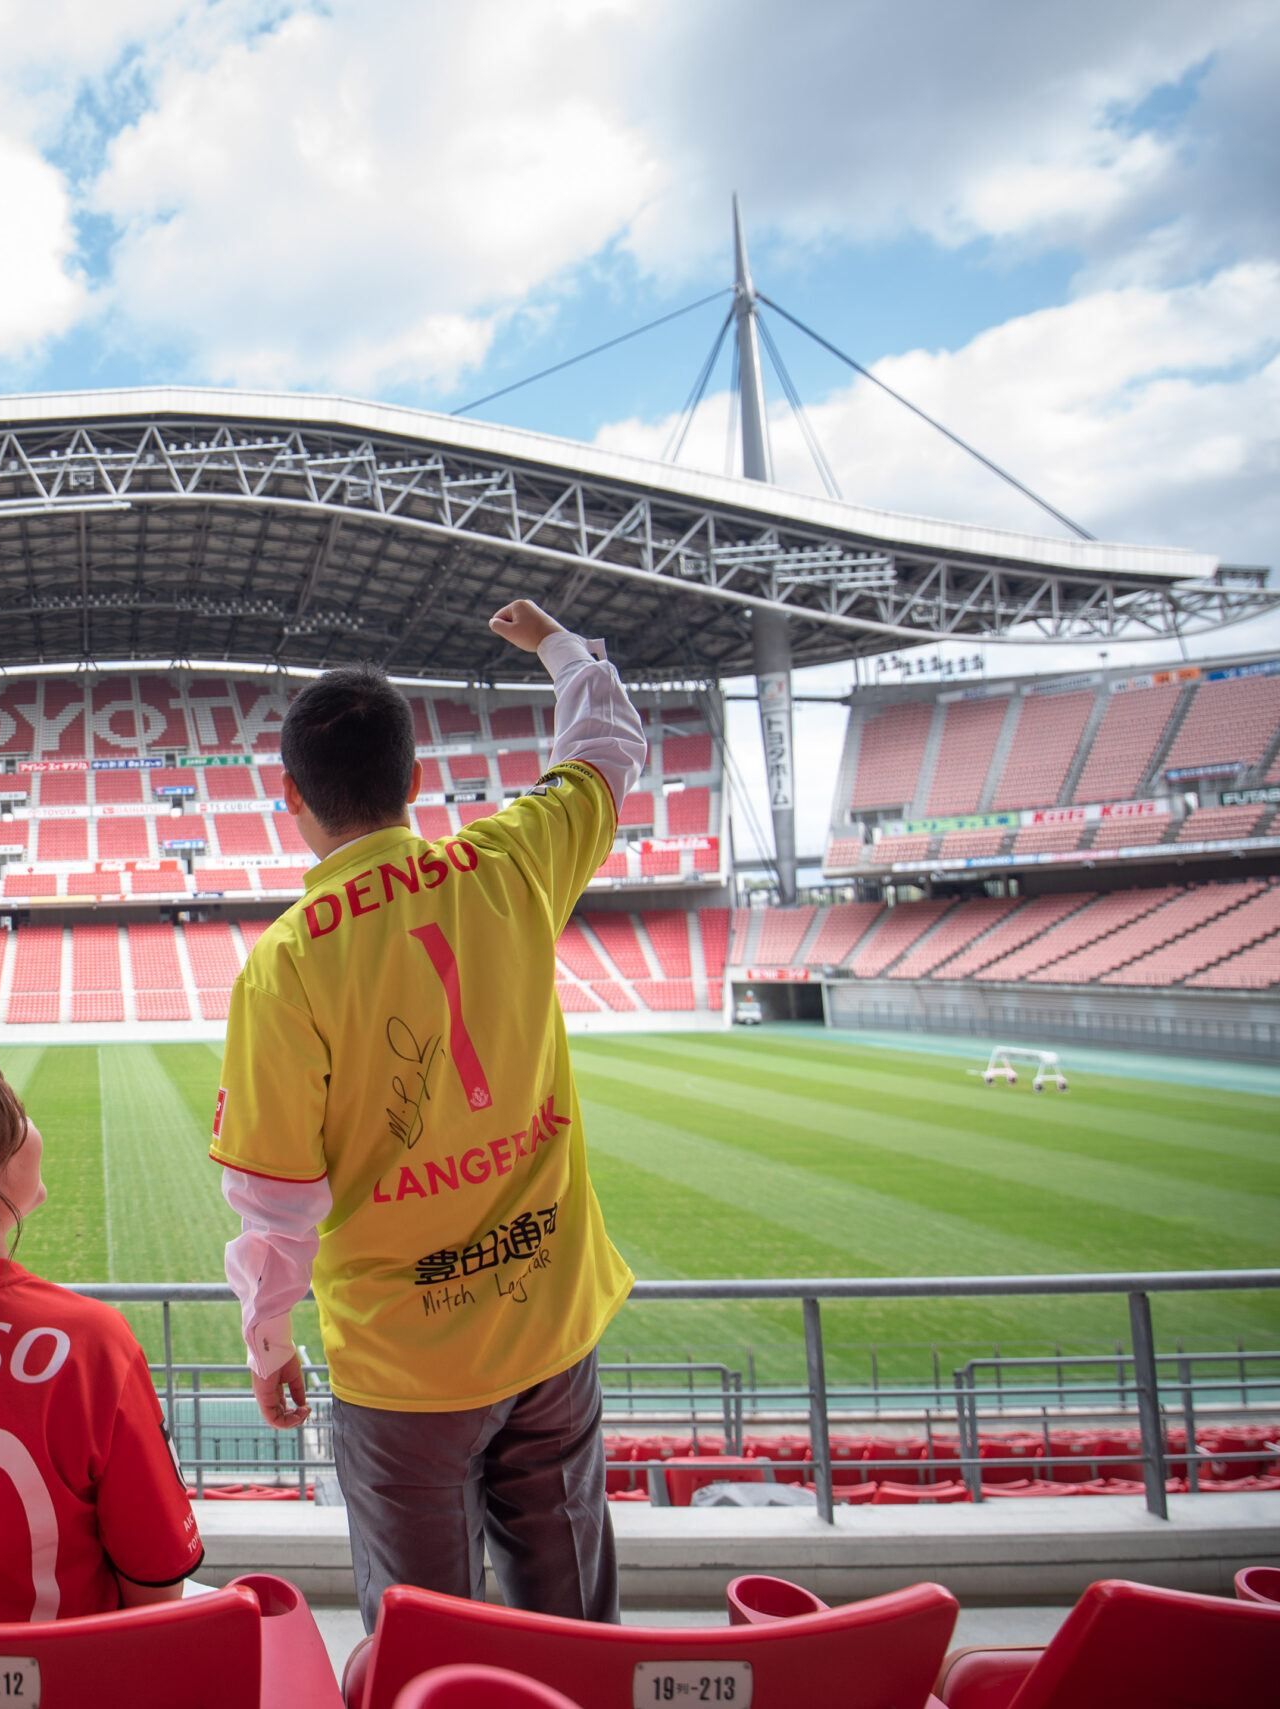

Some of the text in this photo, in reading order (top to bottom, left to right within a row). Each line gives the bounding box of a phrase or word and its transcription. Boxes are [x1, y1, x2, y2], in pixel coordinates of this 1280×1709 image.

[766, 717, 789, 806] トヨタホーム
[43, 808, 77, 816] TOYOTA
[1223, 788, 1280, 806] FUTAB
[652, 836, 711, 852] makita
[302, 840, 478, 940] DENSO
[408, 922, 493, 1113] 1
[422, 1283, 476, 1317] Mitch
